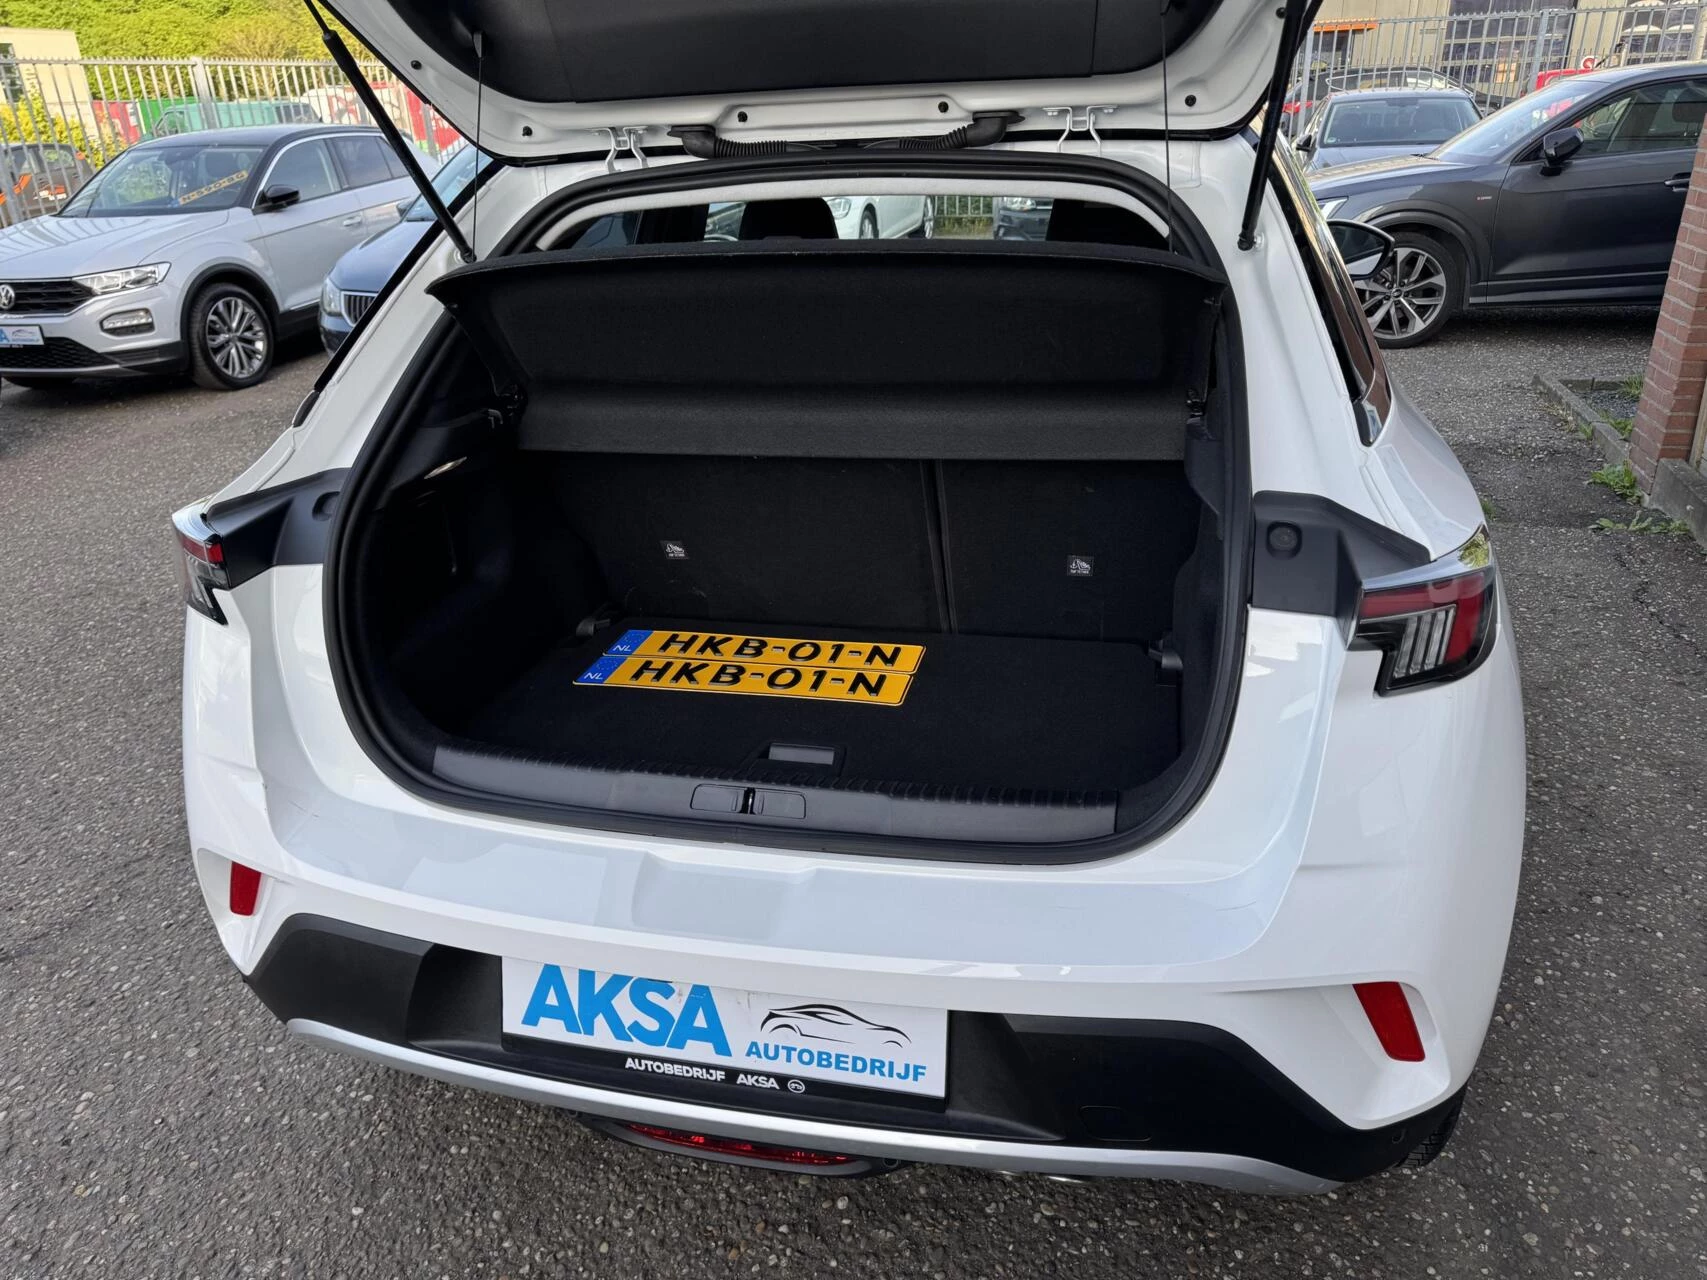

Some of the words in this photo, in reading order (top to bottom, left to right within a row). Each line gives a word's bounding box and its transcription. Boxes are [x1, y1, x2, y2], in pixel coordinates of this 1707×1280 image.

[657, 633, 902, 666] HKB-01-N
[583, 672, 604, 680] NL
[629, 660, 887, 697] HKB-01-N
[521, 963, 732, 1057] AKSA
[625, 1057, 726, 1082] AUTOBEDRIJF
[736, 1074, 780, 1090] AKSA
[745, 1041, 927, 1082] AUTOBEDRIJF
